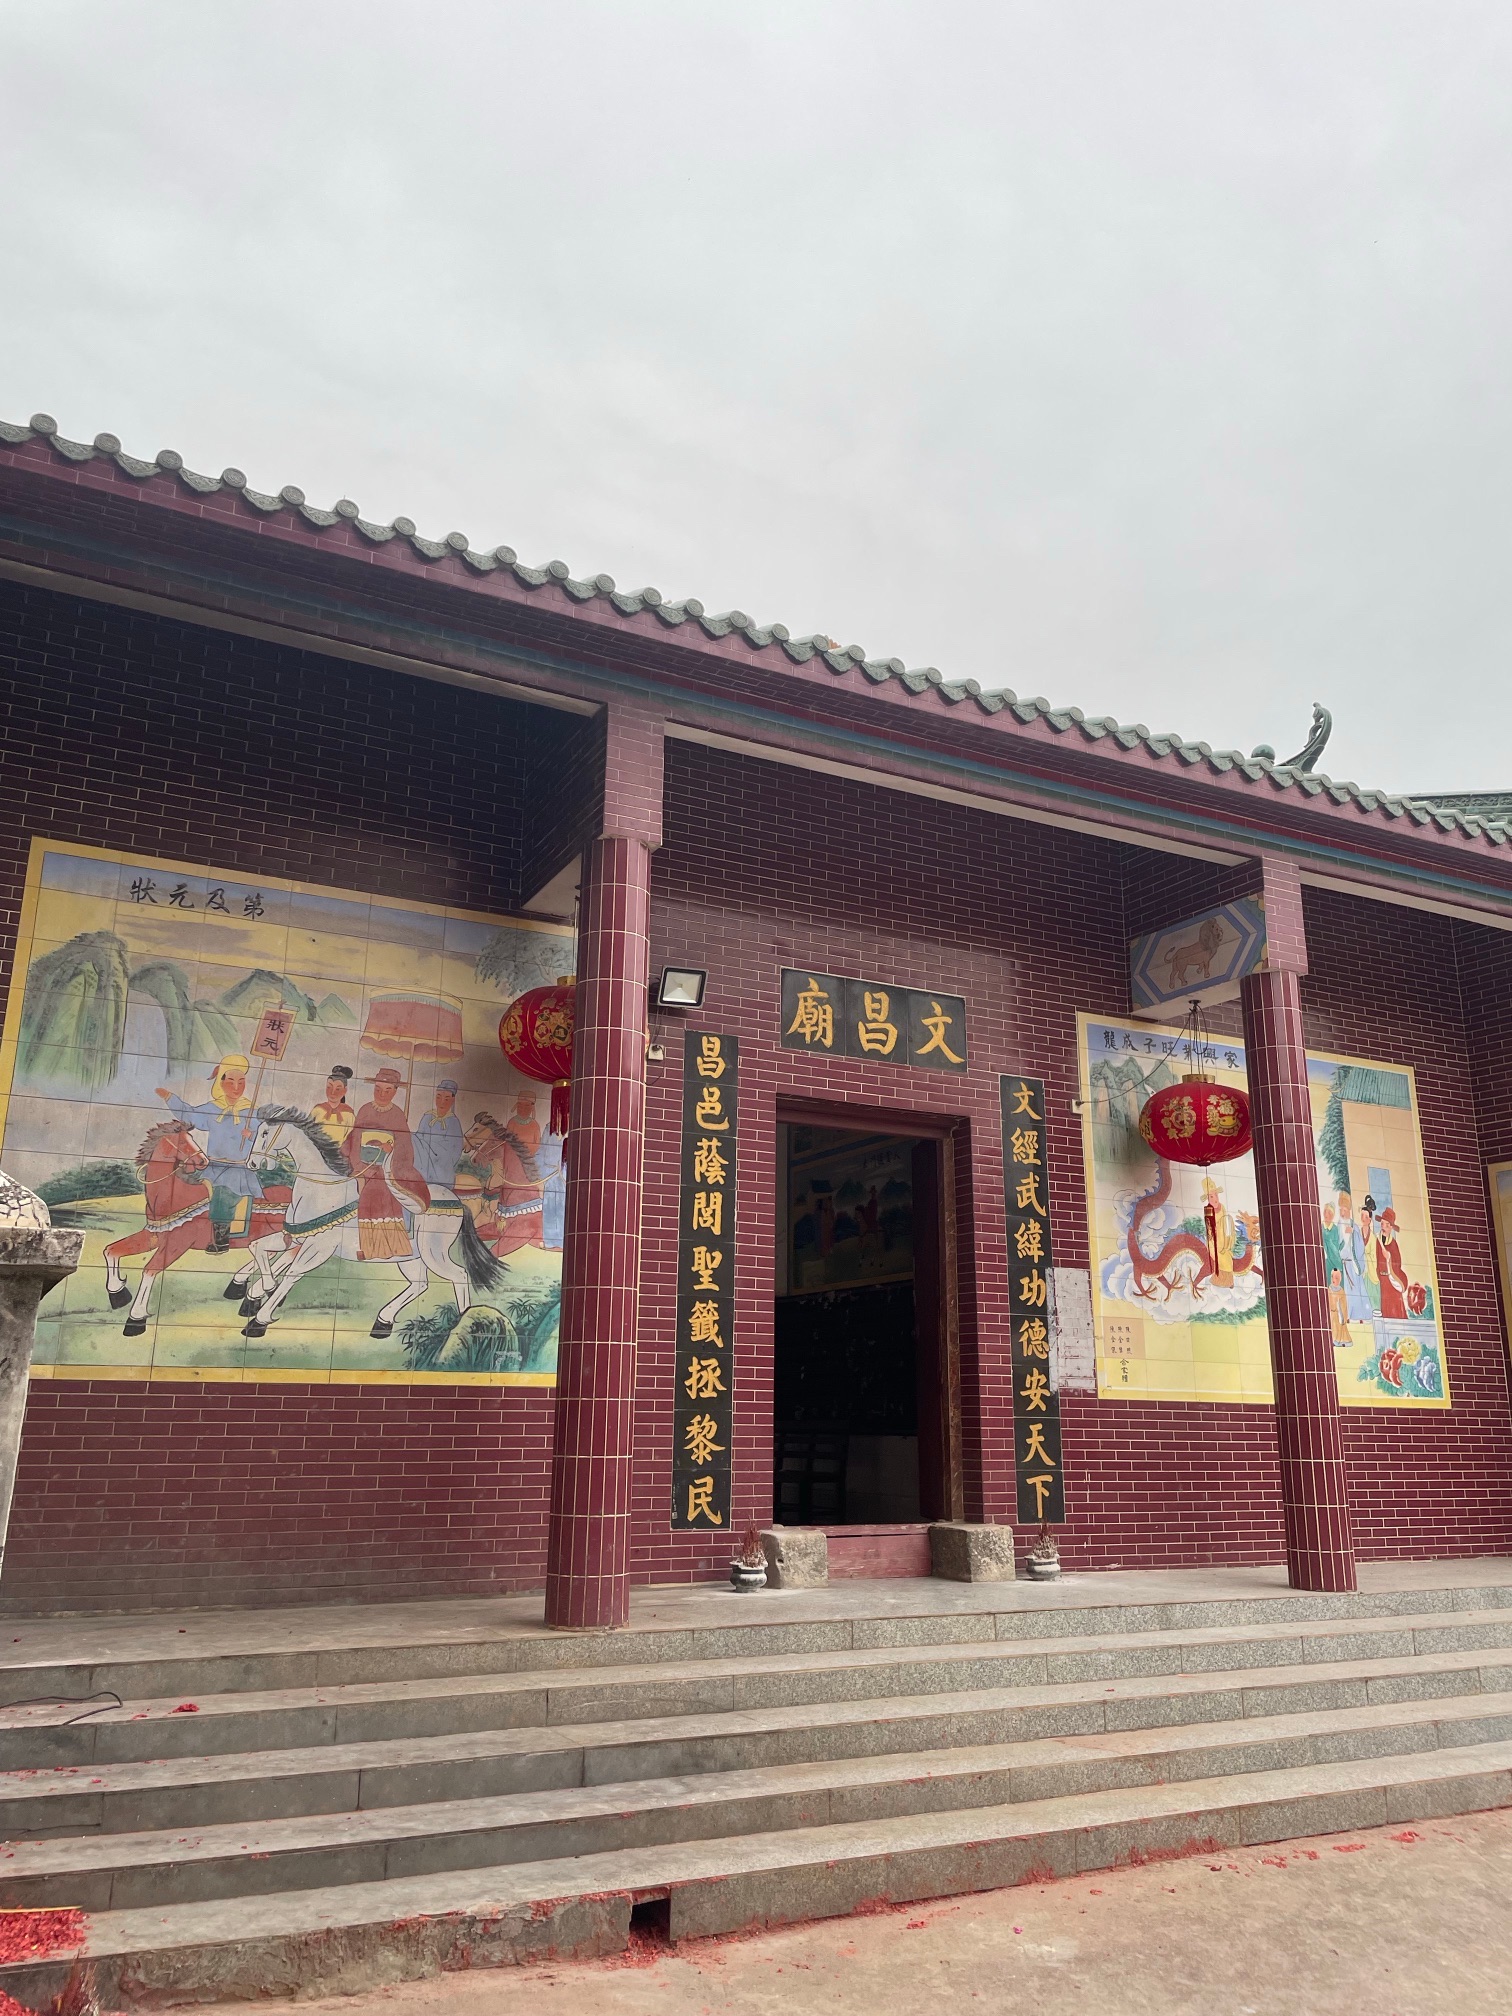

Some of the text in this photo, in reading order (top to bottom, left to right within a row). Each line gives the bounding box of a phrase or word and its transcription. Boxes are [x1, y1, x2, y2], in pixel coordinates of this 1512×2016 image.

[129, 876, 265, 920] 狀元及第
[260, 1019, 285, 1052] 狀元
[785, 977, 966, 1064] 文昌廟
[1010, 1081, 1056, 1519] 文經武緯功德安天下
